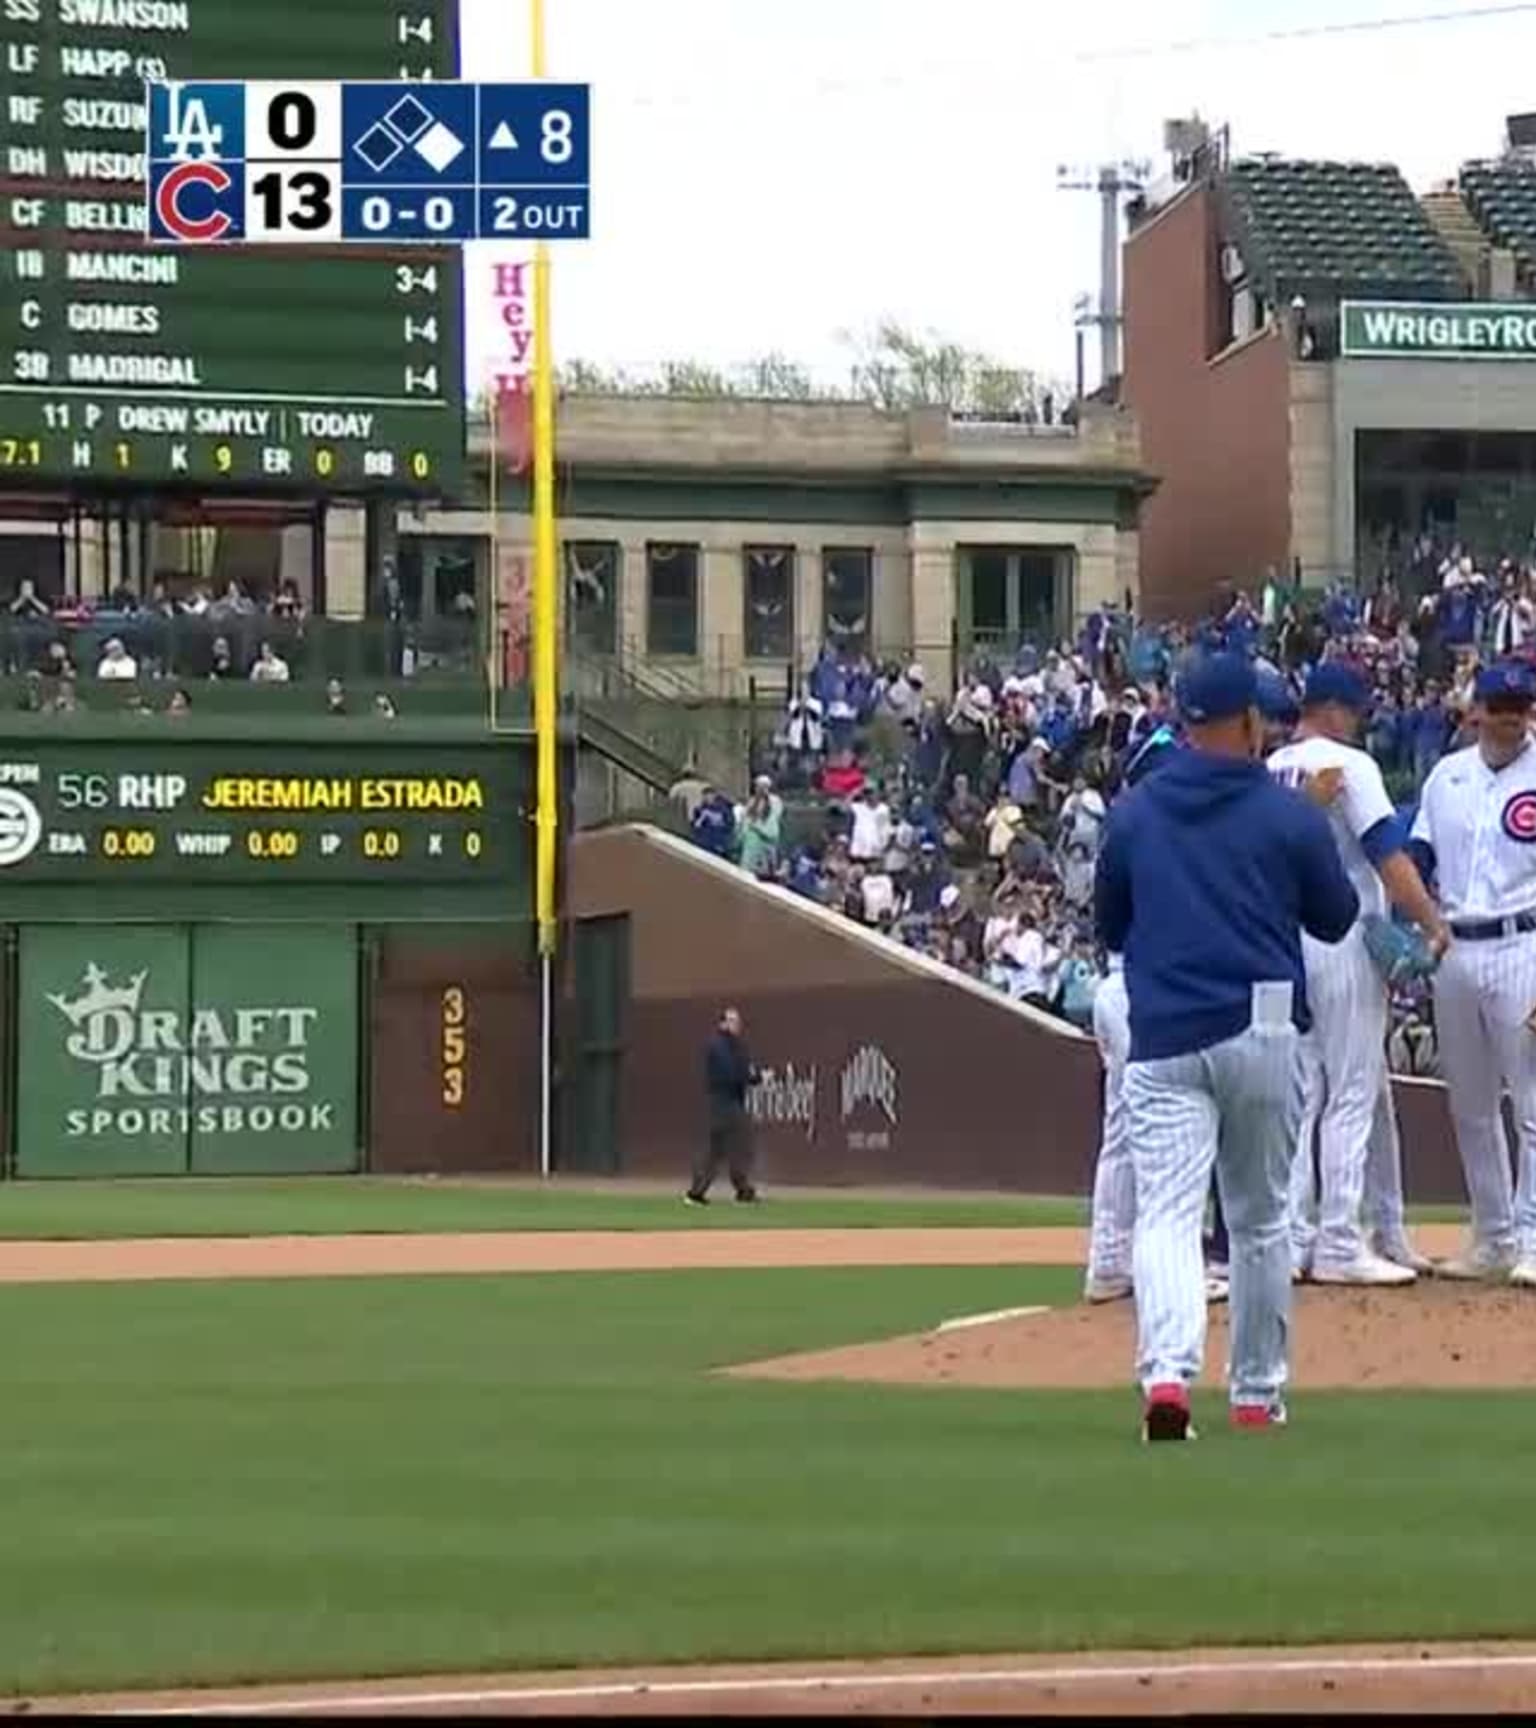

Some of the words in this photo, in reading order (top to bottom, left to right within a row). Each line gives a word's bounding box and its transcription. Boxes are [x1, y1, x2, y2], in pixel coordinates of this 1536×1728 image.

[5, 0, 40, 21] SS
[59, 0, 188, 30] SWANSON
[8, 44, 40, 72] LF
[61, 47, 130, 76] HAPP
[8, 96, 43, 124] RF
[8, 148, 46, 176] DH
[11, 199, 46, 226] CF
[66, 253, 178, 283] MANCINI
[397, 265, 437, 294] 3-4
[21, 300, 40, 328] C
[68, 303, 159, 333] GOMES
[404, 316, 438, 343] 1-4
[14, 351, 48, 379] 3B
[68, 354, 200, 384] MADRIGAL
[404, 366, 438, 393] 1-4
[43, 404, 69, 428] 11
[85, 404, 101, 429] P
[118, 406, 188, 432] DREW
[194, 409, 269, 435] SMYLY
[297, 412, 373, 438] TODAY
[1, 441, 41, 465] 7.1
[73, 441, 90, 467] H
[117, 444, 129, 468] 1
[171, 444, 188, 469] K
[216, 446, 231, 470] 9
[263, 447, 291, 474] ER
[316, 451, 332, 474] 0
[364, 451, 393, 475] BB
[413, 453, 428, 477] 0
[59, 774, 109, 808] 56
[118, 775, 186, 808] RHP
[202, 779, 351, 808] JEREMIAH
[361, 779, 483, 808] ESTRADA
[48, 832, 86, 853] ERA
[103, 831, 154, 856] 0.00
[175, 832, 232, 854] WHIP
[248, 831, 297, 856] 0.00
[320, 833, 341, 855] IP
[364, 832, 399, 856] 0.0
[466, 831, 481, 857] 0
[66, 1007, 318, 1061] DRAFT
[444, 988, 464, 1103] 353
[97, 1052, 310, 1098] KINGS
